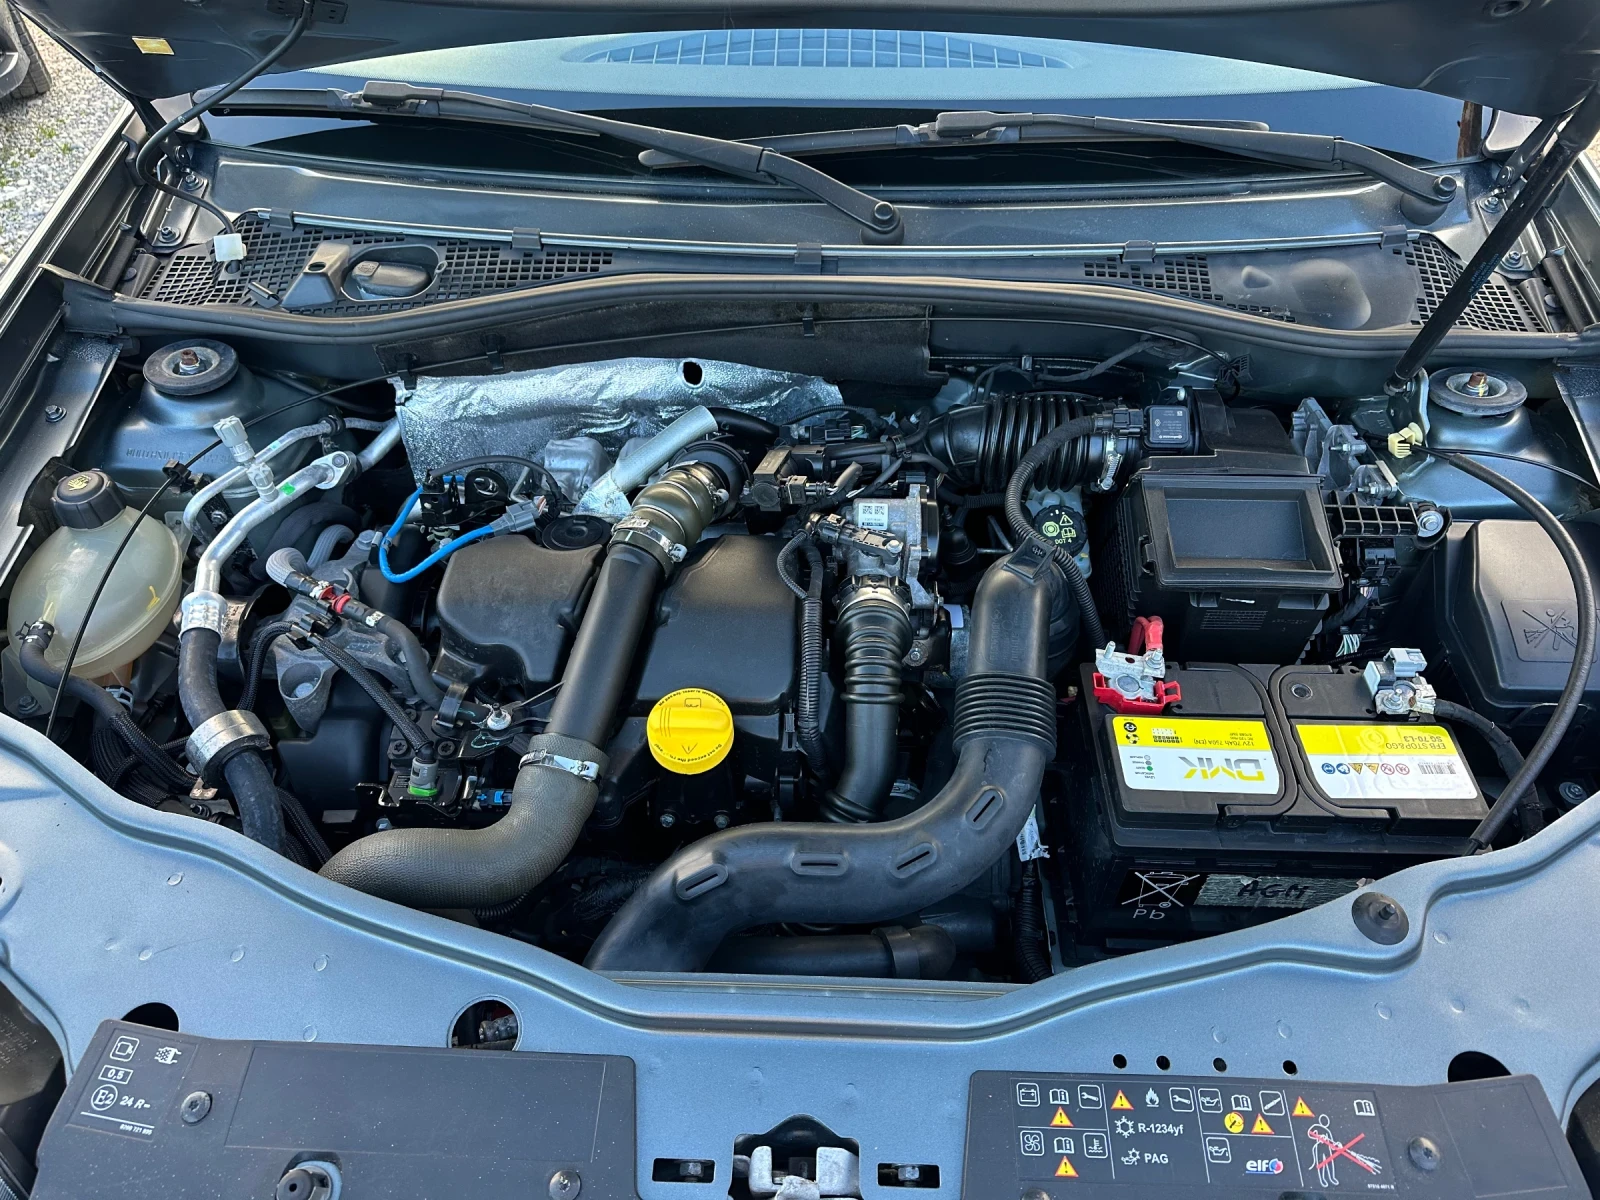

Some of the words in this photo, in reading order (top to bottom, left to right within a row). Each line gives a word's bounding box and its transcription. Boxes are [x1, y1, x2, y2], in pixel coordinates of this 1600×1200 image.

[1178, 756, 1265, 782] DMK
[1238, 880, 1310, 899] AGM
[1133, 909, 1165, 920] Pb
[108, 1069, 124, 1080] 0,5
[94, 1089, 114, 1105] E2
[120, 1096, 134, 1107] 24
[1138, 1123, 1184, 1137] R-1234yf
[1144, 1153, 1168, 1164] PAG
[1246, 1160, 1270, 1172] elf
